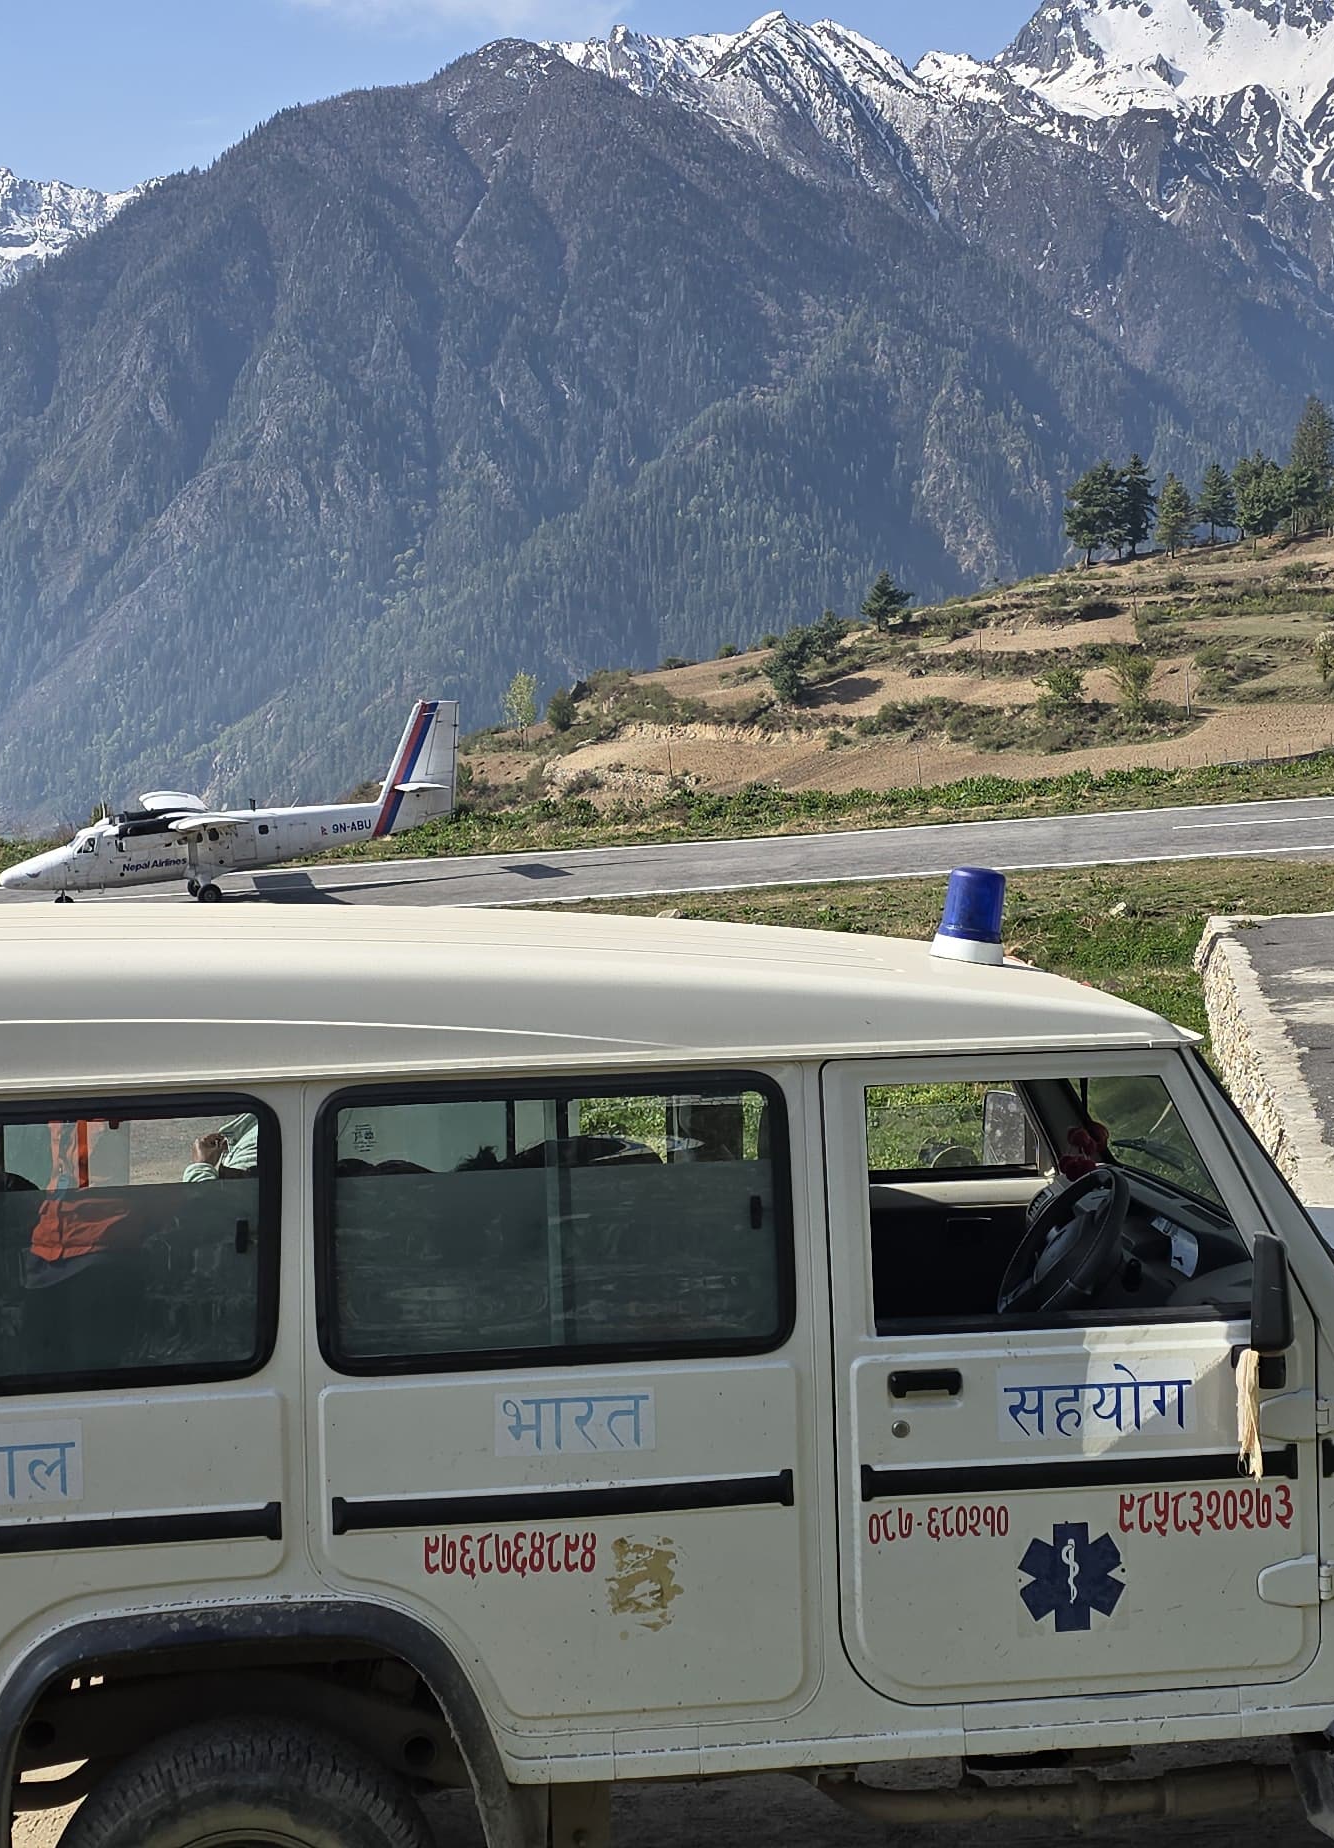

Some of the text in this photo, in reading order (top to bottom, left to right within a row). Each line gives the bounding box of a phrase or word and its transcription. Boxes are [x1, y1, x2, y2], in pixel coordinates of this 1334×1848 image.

[331, 818, 372, 834] 9N-ABU
[122, 857, 188, 873] Nepal Airlines
[1003, 1362, 1192, 1436] सहयोग
[501, 1391, 651, 1450] भारत
[868, 1505, 1009, 1545] ०८७-६८०२१०
